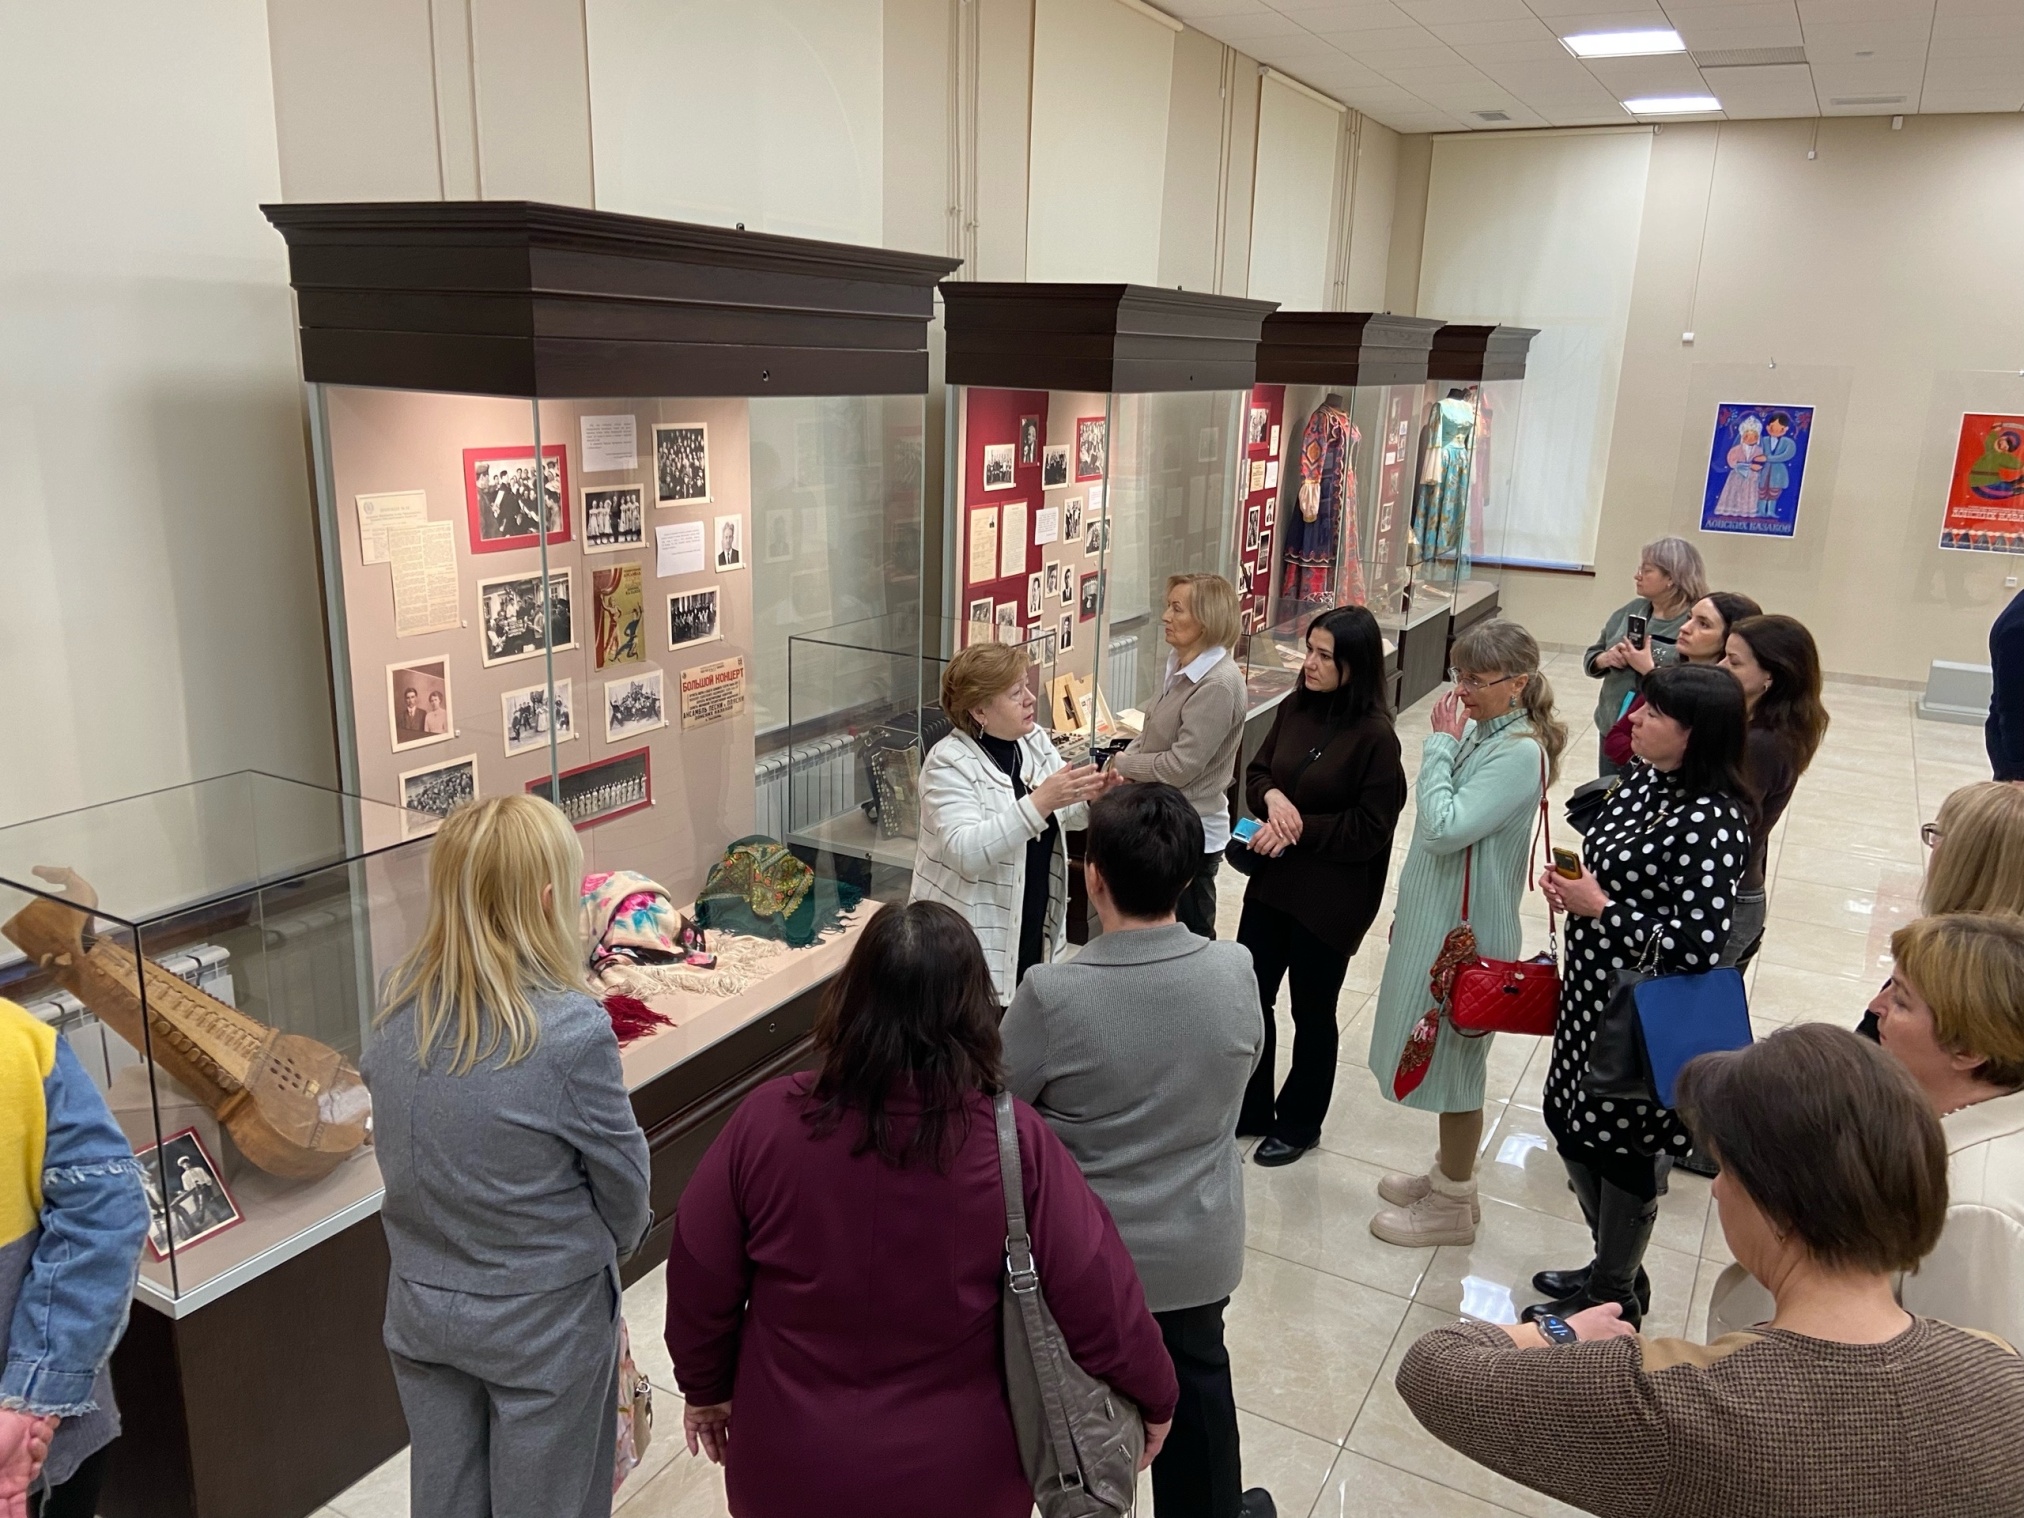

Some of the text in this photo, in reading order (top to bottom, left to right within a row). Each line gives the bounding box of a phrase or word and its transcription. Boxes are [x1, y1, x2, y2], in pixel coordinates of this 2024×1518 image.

[682, 668, 744, 692] БОЛЬШОЙ КОНЦЕРТ
[683, 707, 708, 719] АНСАМБЛЬ
[709, 702, 723, 711] ПЕСНИ
